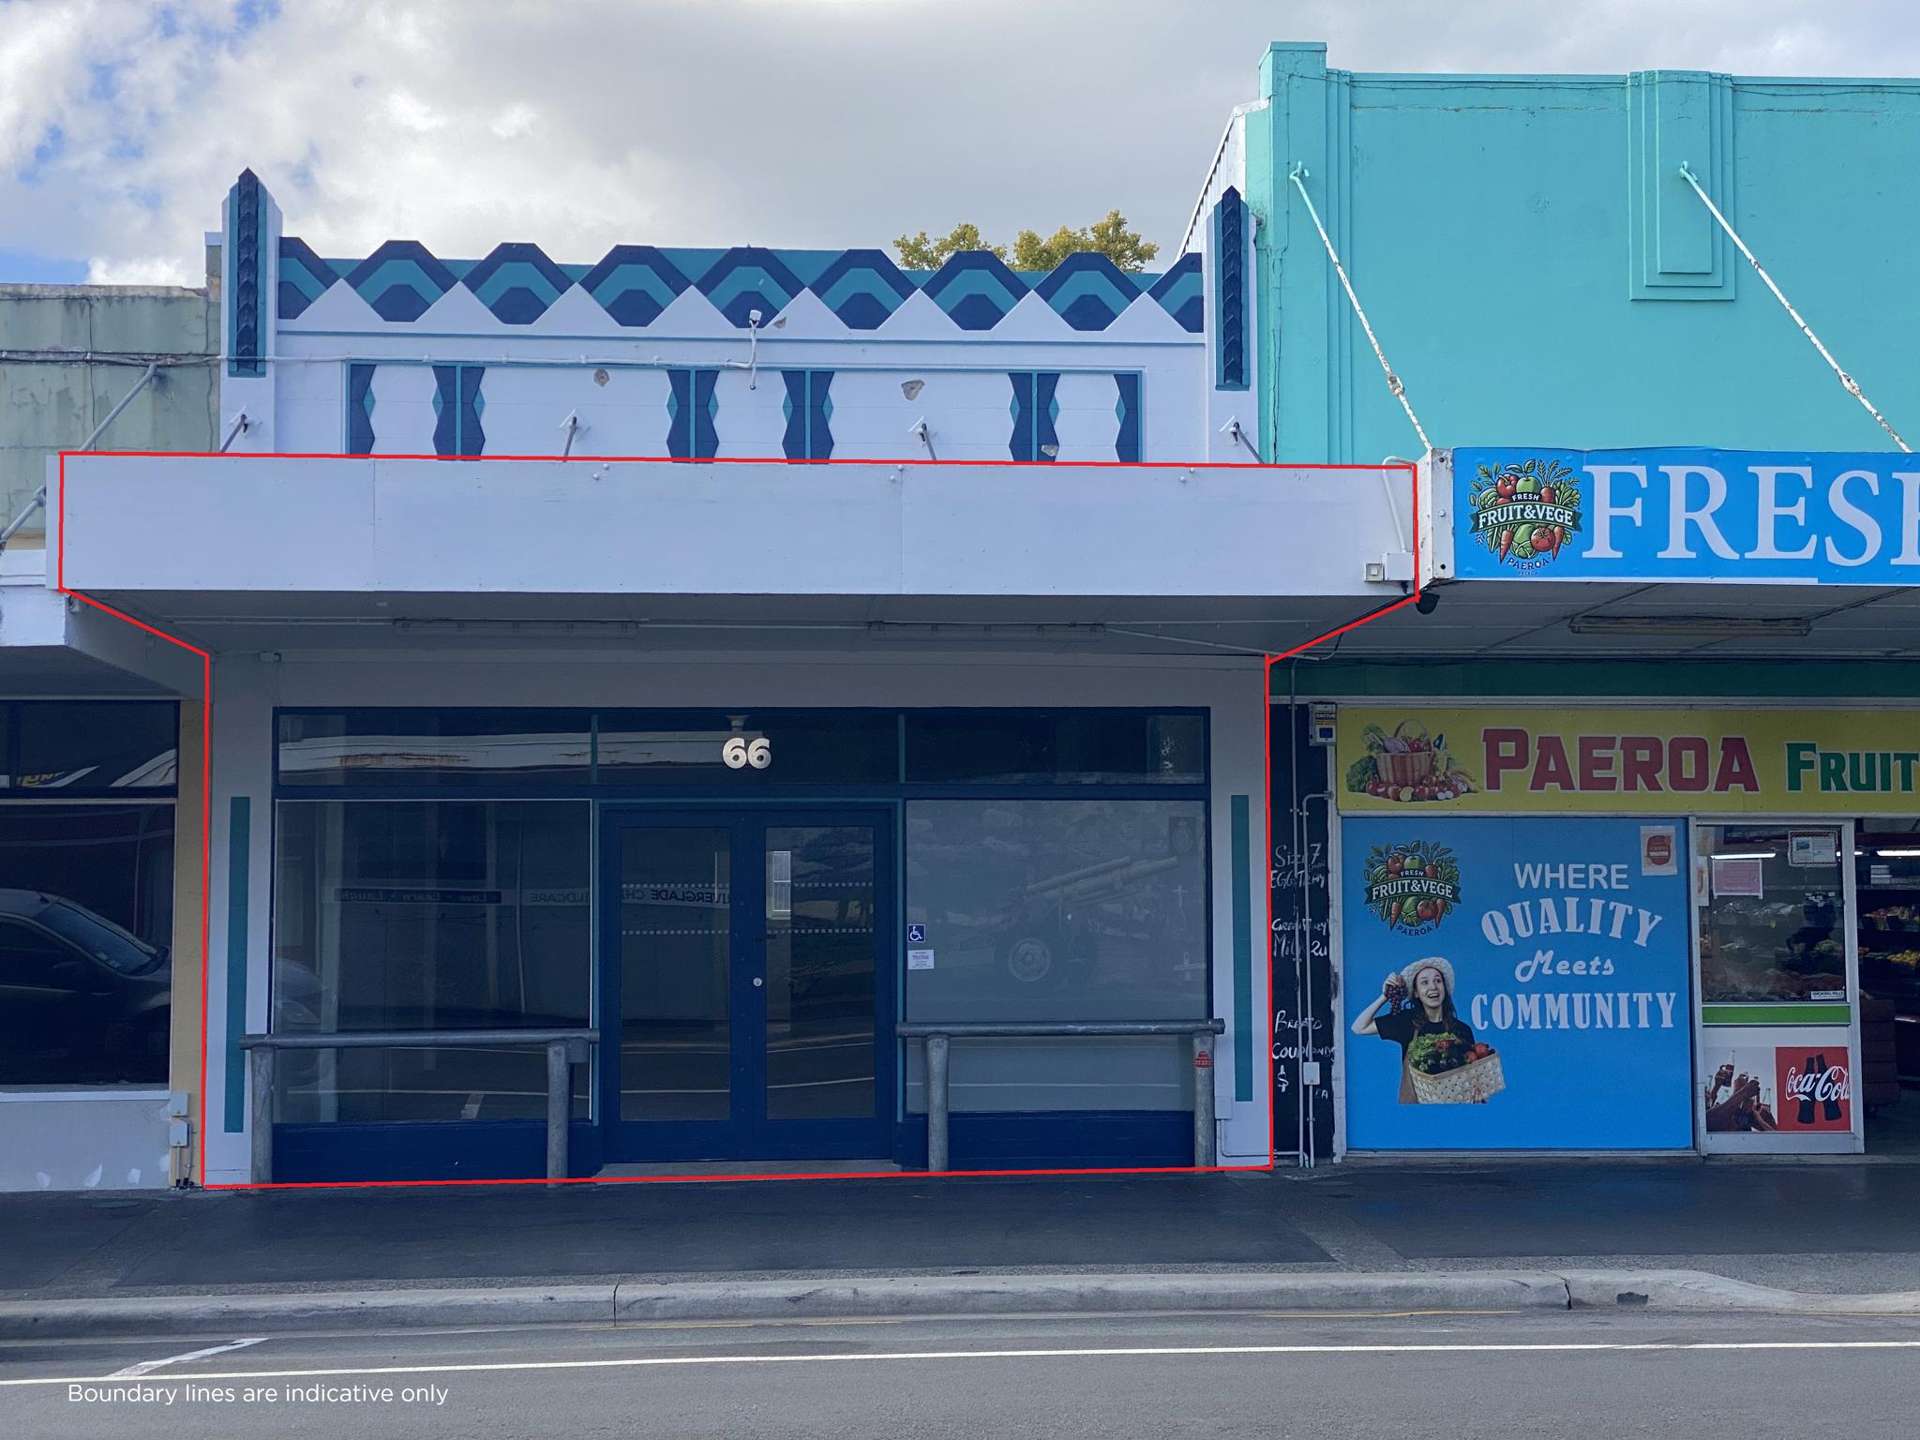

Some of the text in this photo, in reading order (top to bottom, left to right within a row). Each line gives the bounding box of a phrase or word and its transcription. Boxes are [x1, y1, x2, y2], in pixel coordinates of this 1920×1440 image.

[1511, 493, 1540, 502] FRESH
[1479, 504, 1573, 529] FRUIT&VEGE
[1507, 556, 1549, 571] PAEROA
[723, 737, 772, 769] 66
[1481, 727, 1920, 794] PAEROA FRUIT
[1400, 869, 1425, 877] FRESH
[1513, 863, 1630, 890] WHERE
[1372, 880, 1453, 900] FRUIT&VEGE
[1396, 924, 1433, 937] PAEROA
[1481, 896, 1663, 948] QUALITY
[1514, 949, 1615, 983] Meets
[1470, 992, 1677, 1031] COMMUNITY
